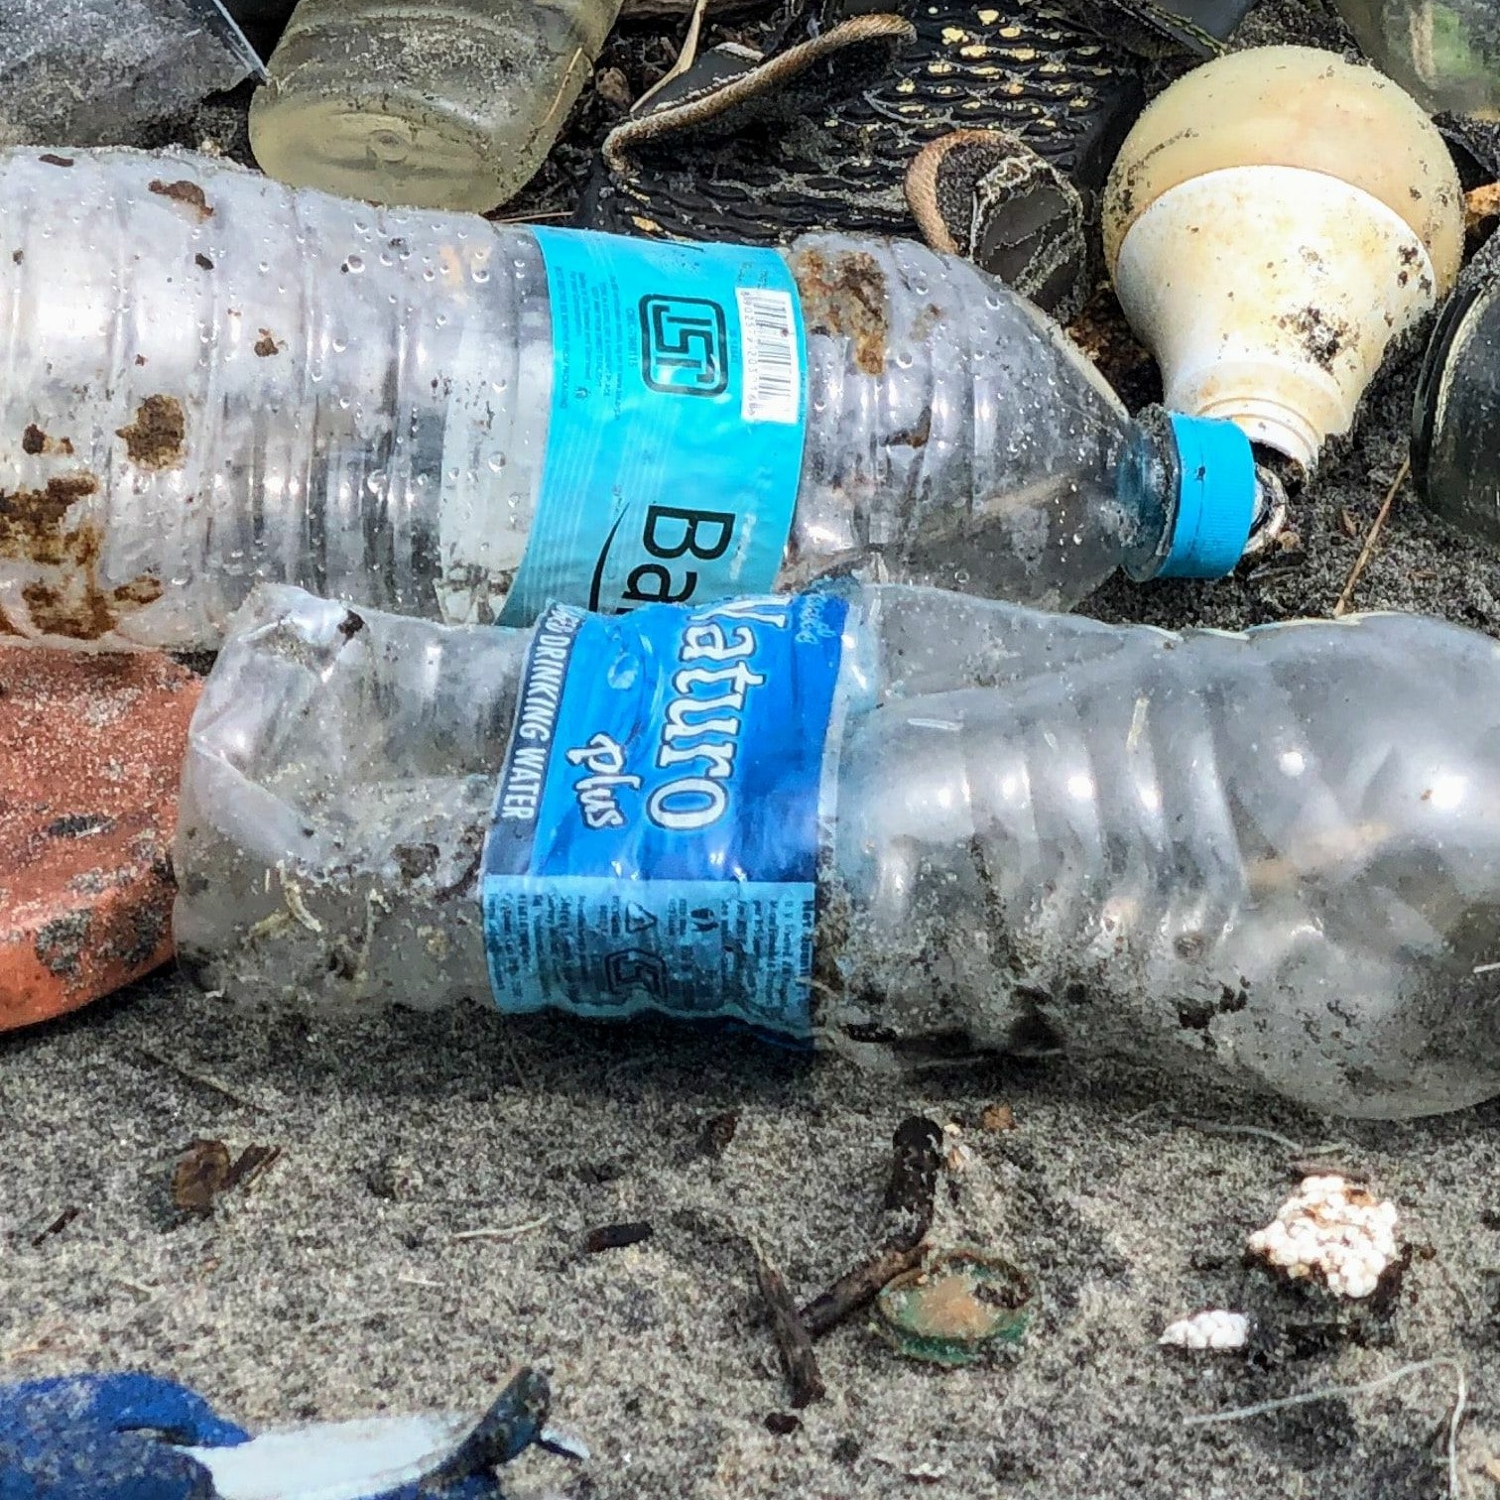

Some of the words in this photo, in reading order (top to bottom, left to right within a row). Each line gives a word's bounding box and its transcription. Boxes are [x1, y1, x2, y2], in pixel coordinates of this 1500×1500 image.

[615, 505, 736, 615] Ba
[519, 634, 568, 740] DRINKING
[503, 747, 546, 820] WATER
[567, 733, 641, 829] plus
